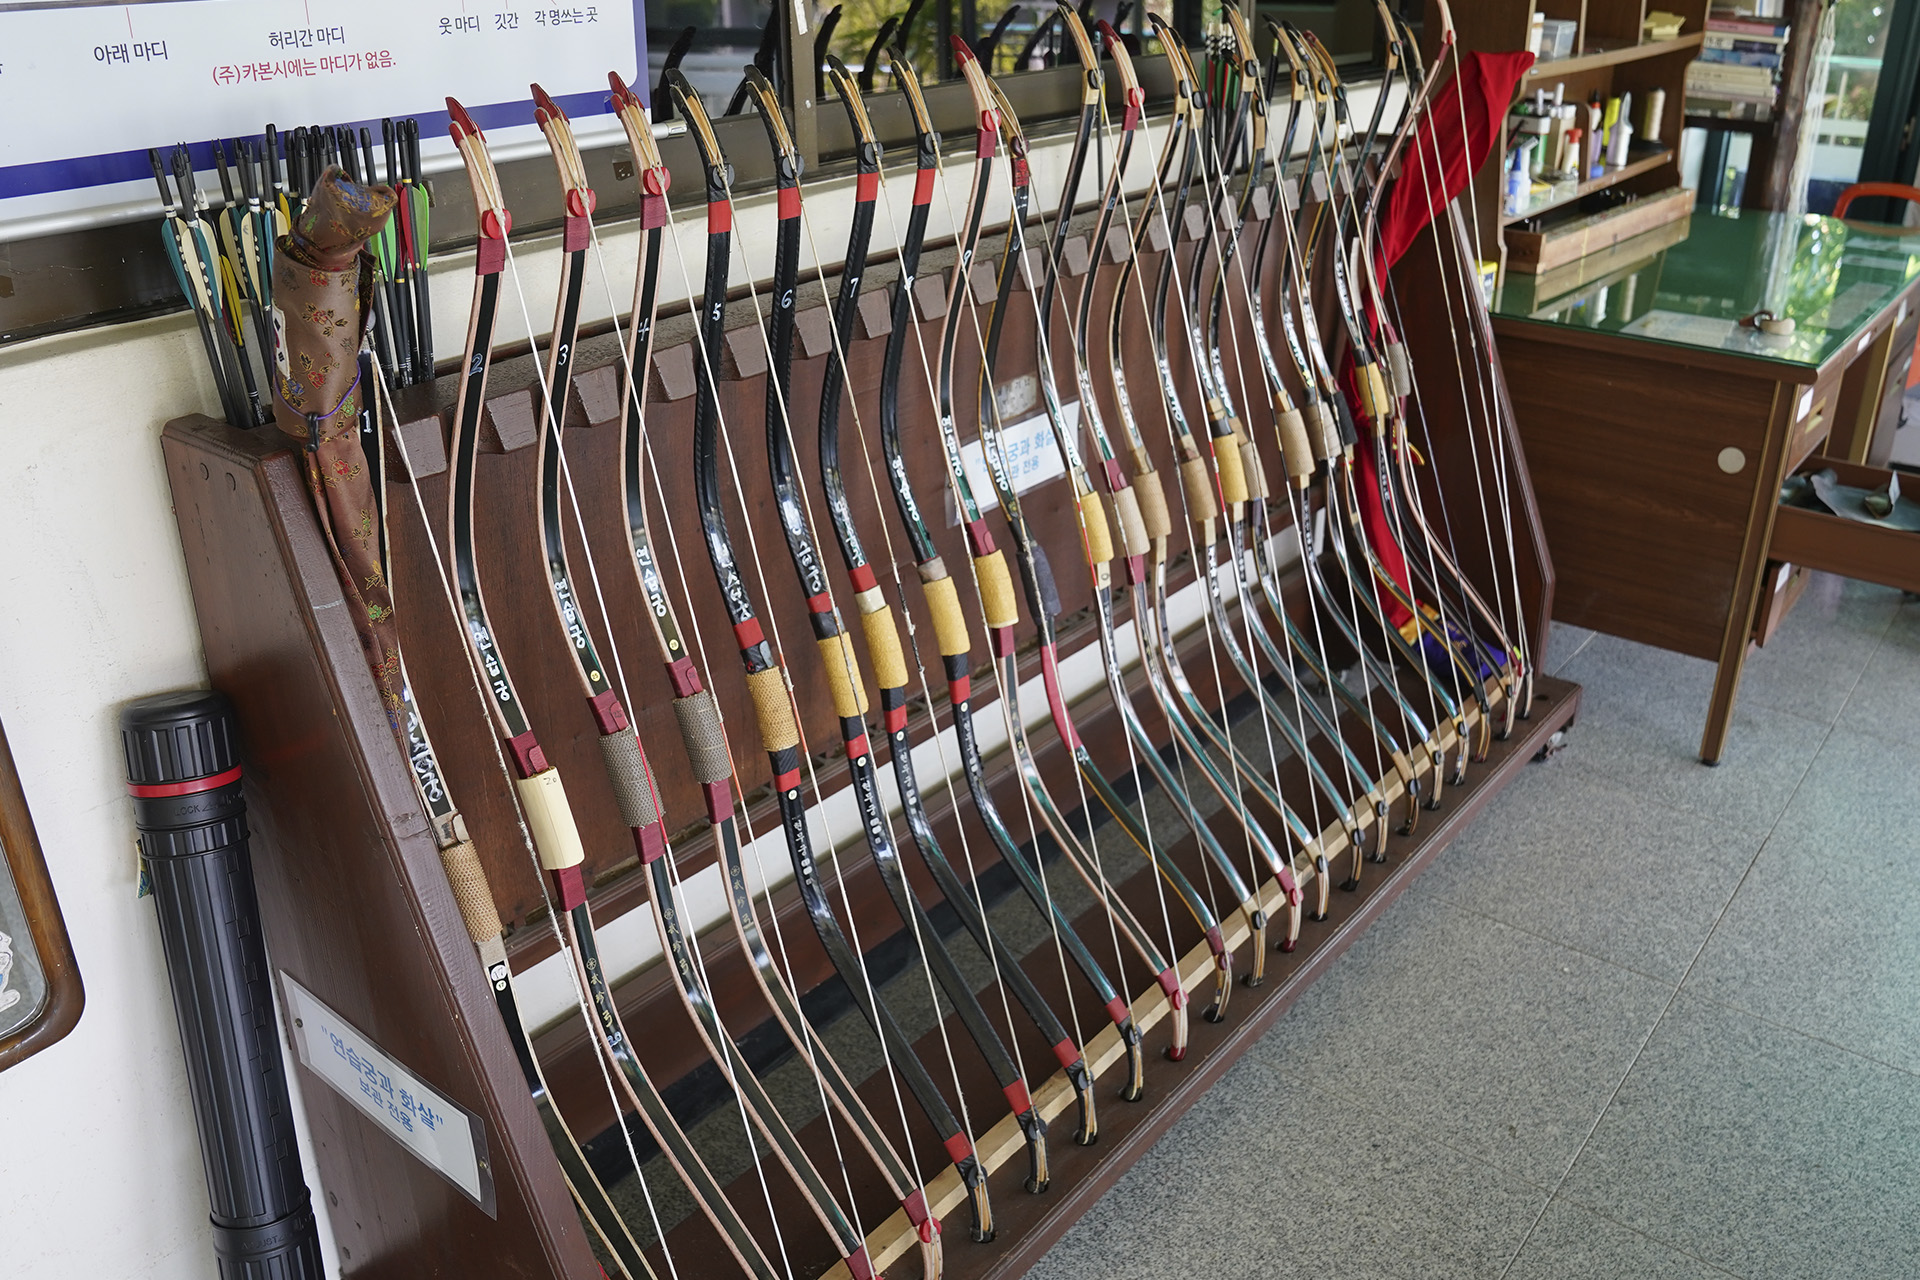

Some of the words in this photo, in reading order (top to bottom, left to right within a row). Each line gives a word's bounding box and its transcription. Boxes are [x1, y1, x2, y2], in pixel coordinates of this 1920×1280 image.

[439, 17, 452, 35] 웃
[455, 15, 480, 33] 마디
[494, 12, 519, 30] 깃간
[534, 10, 547, 27] 각
[549, 8, 584, 26] 명쓰는
[586, 6, 598, 23] 곳
[268, 29, 313, 49] 허리간
[316, 26, 345, 46] 마디
[93, 43, 130, 64] 아래
[133, 40, 168, 61] 마디
[320, 53, 362, 74] 마디가
[365, 49, 397, 70] 없음.
[781, 289, 793, 309] 6
[850, 277, 859, 299] 7
[712, 302, 722, 322] 5
[638, 317, 650, 341] 4
[468, 353, 484, 377] 2
[558, 343, 569, 366] 3
[363, 410, 373, 434] 1
[942, 415, 963, 477] 연습궁
[636, 545, 668, 617] 연습궁
[554, 578, 586, 649] 연습궁
[474, 626, 511, 702] 연습궁
[359, 1077, 384, 1109] 보관
[387, 1100, 413, 1132] 전용
